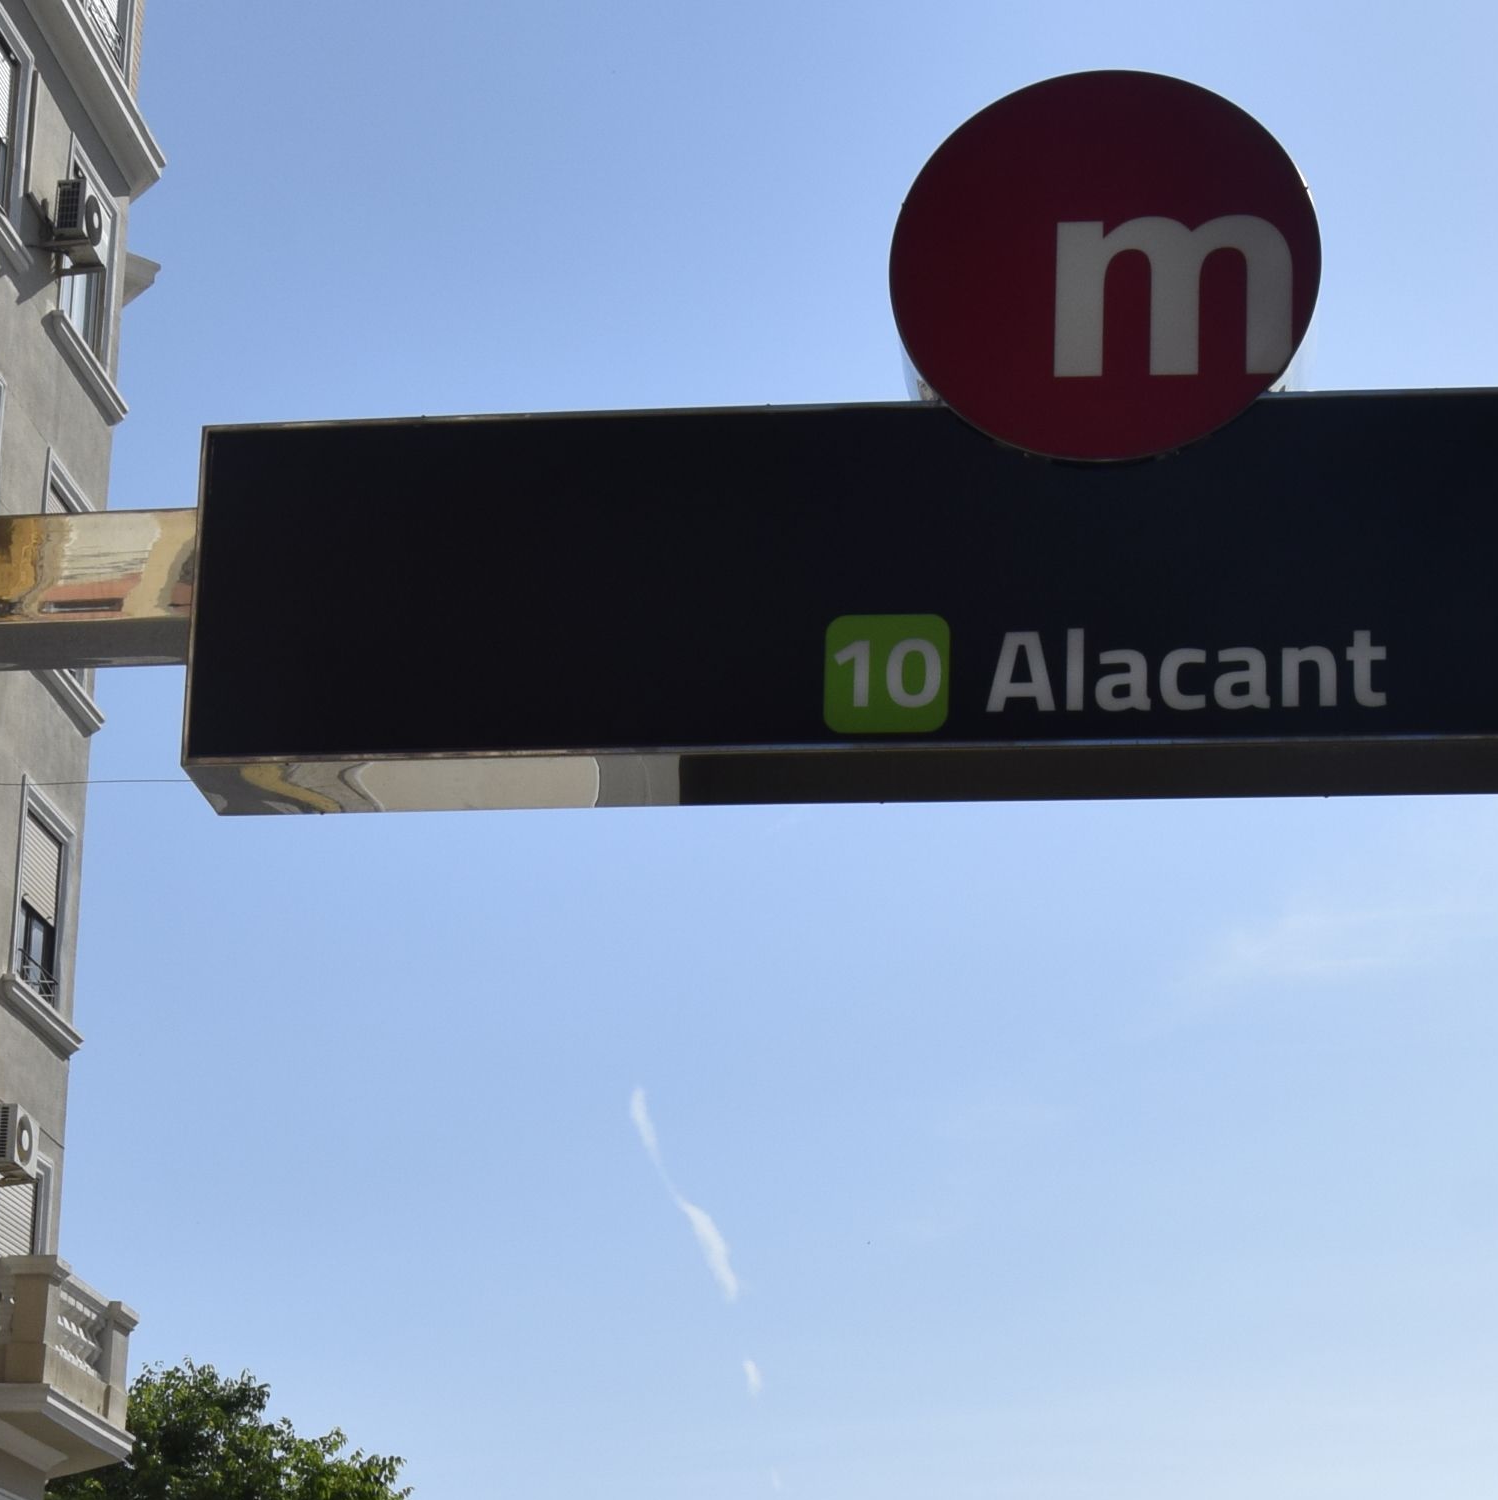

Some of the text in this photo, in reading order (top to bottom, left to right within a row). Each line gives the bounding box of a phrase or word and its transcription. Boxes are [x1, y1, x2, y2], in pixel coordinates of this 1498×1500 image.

[1054, 214, 1293, 377] m
[833, 628, 1388, 713] 10 Alacant
